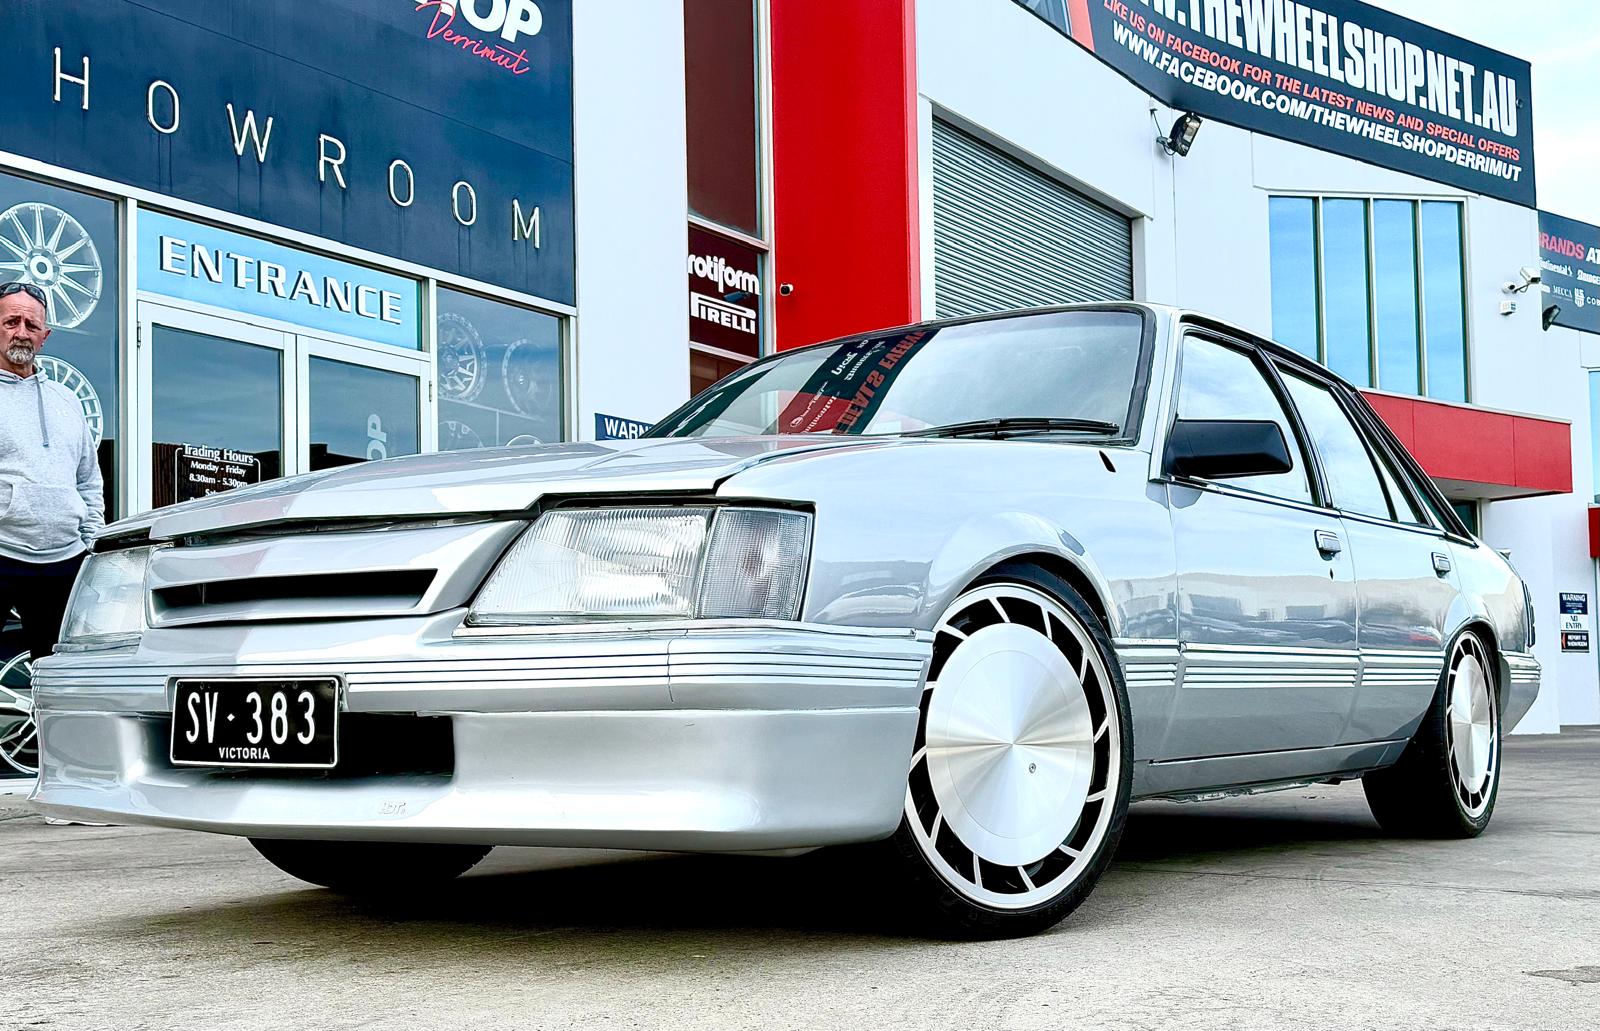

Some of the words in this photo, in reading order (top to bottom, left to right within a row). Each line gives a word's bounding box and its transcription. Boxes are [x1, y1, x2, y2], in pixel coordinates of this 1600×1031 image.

[415, 1, 530, 75] Derrimut
[1104, 0, 1128, 23] LIKE
[1129, 11, 1145, 32] US
[1147, 23, 1165, 43] ON
[1166, 35, 1241, 74] FACEBOOK
[1243, 63, 1271, 86] FOR
[1275, 73, 1301, 94] THE
[1303, 83, 1354, 110] LATEST
[1356, 100, 1394, 123] NEWS
[1397, 113, 1424, 132] AND
[1426, 121, 1475, 148] SPECIAL
[1478, 138, 1520, 161] OFFERS
[1113, 19, 1522, 182] WWW.FACEBOOK.COM/THEWHEELSHOPDERRIMUT
[158, 234, 403, 323] ENTRANCE
[688, 254, 761, 295] rotiform
[690, 291, 756, 334] PIRELLI
[183, 443, 220, 462] Trading
[223, 449, 254, 464] Hours
[190, 460, 219, 474] Monday
[225, 465, 246, 477] Friday
[189, 473, 216, 485] 8.30am
[1562, 593, 1586, 602] WARNING
[246, 691, 315, 745] 383
[218, 747, 270, 760] VICTORIA
